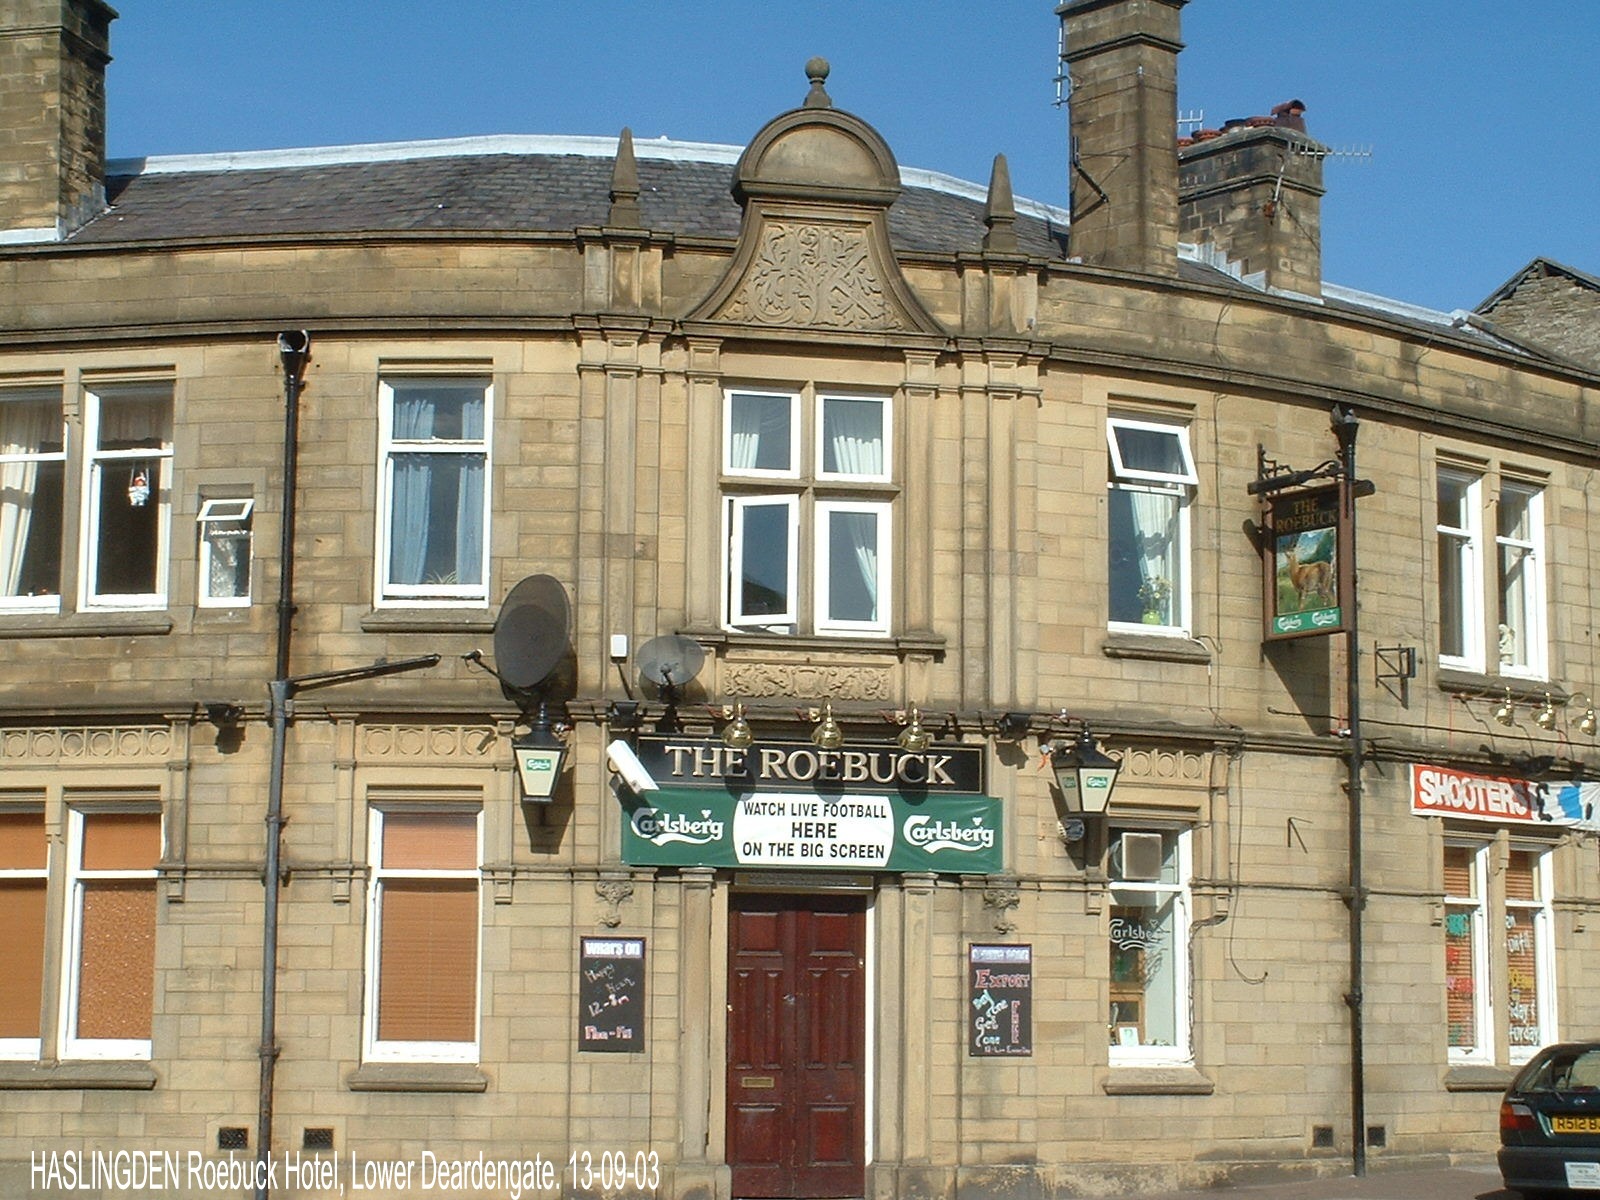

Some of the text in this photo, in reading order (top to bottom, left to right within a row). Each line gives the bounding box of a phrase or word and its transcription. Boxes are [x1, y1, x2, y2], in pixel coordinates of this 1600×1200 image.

[664, 745, 956, 786] THE ROEBUCK
[1419, 770, 1528, 816] SHOOTERS
[743, 802, 888, 820] WATCH LIVE FOOTBALL
[630, 807, 724, 844] Carlsberg
[791, 822, 838, 839] HERE
[903, 814, 995, 850] Carlsberg
[742, 843, 885, 860] ON THE BIG SCREEN
[1109, 919, 1162, 943] Carlsbe
[1557, 1116, 1586, 1130] R512
